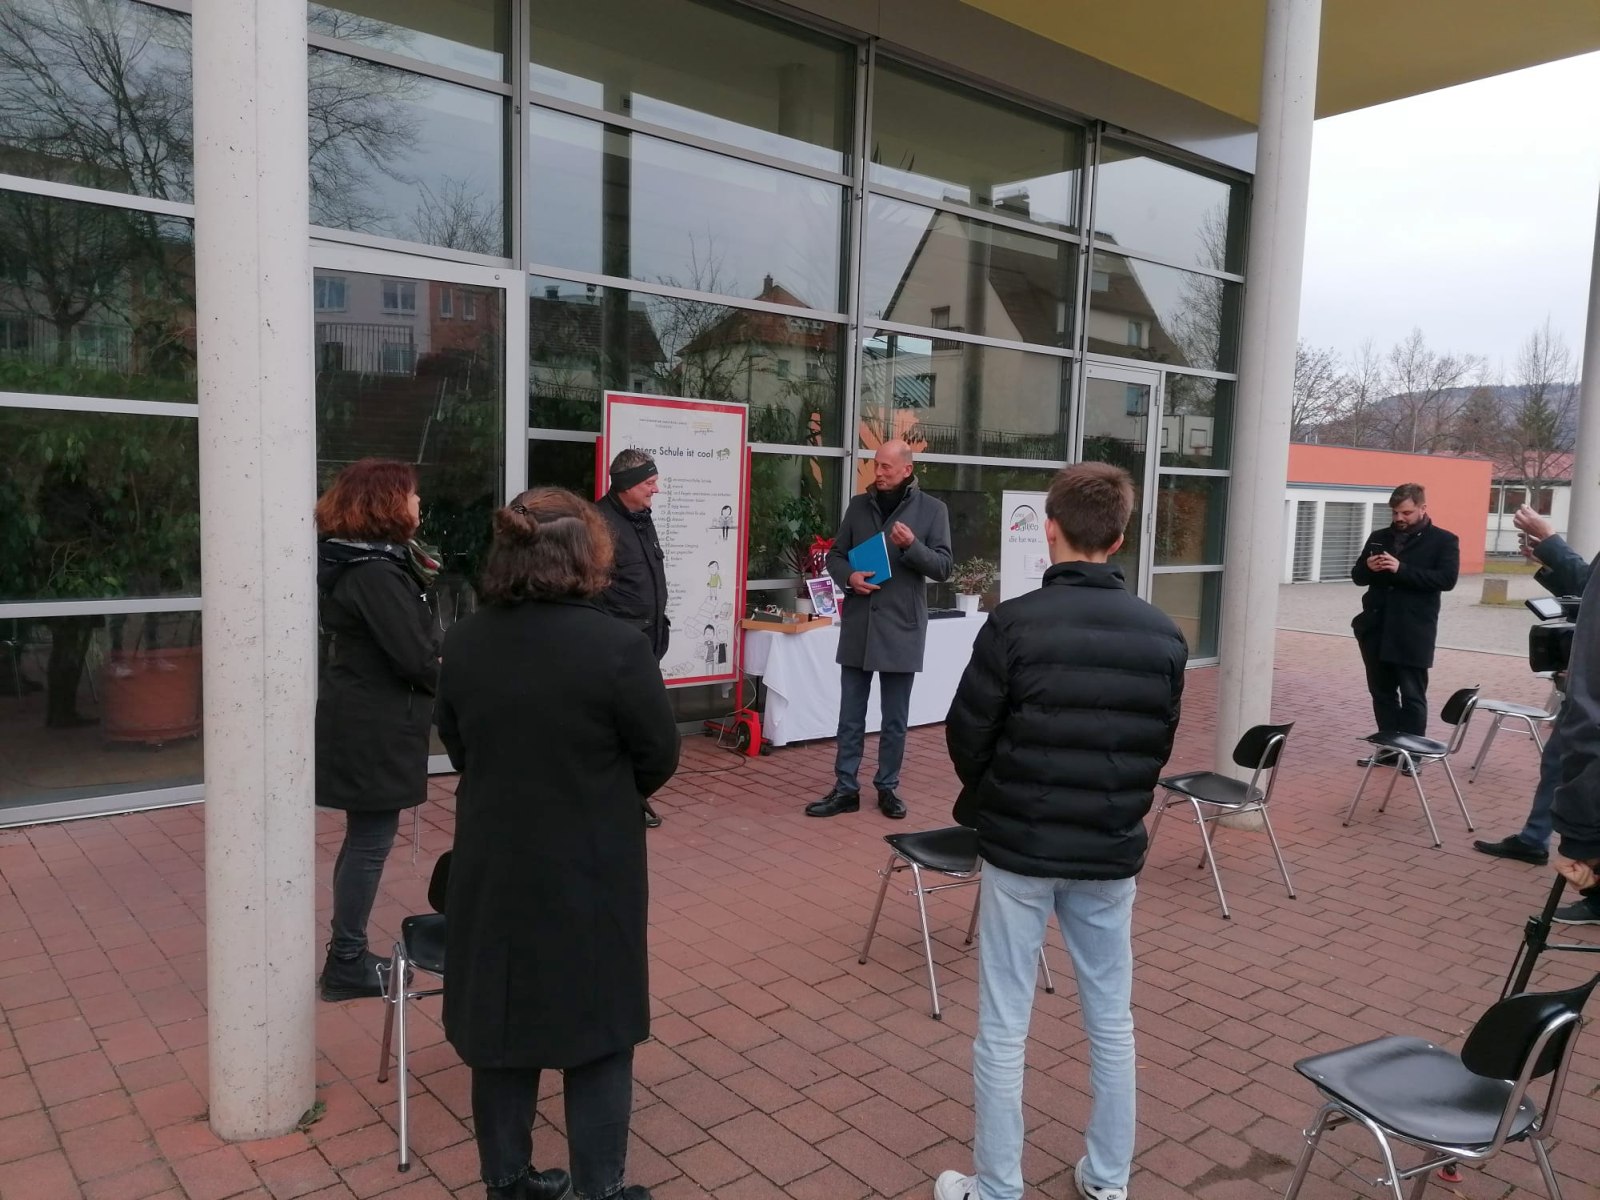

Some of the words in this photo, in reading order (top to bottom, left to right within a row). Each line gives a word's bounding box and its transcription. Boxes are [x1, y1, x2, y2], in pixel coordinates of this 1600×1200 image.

[659, 446, 684, 457] Schule
[686, 448, 694, 457] ist
[697, 449, 714, 458] cool
